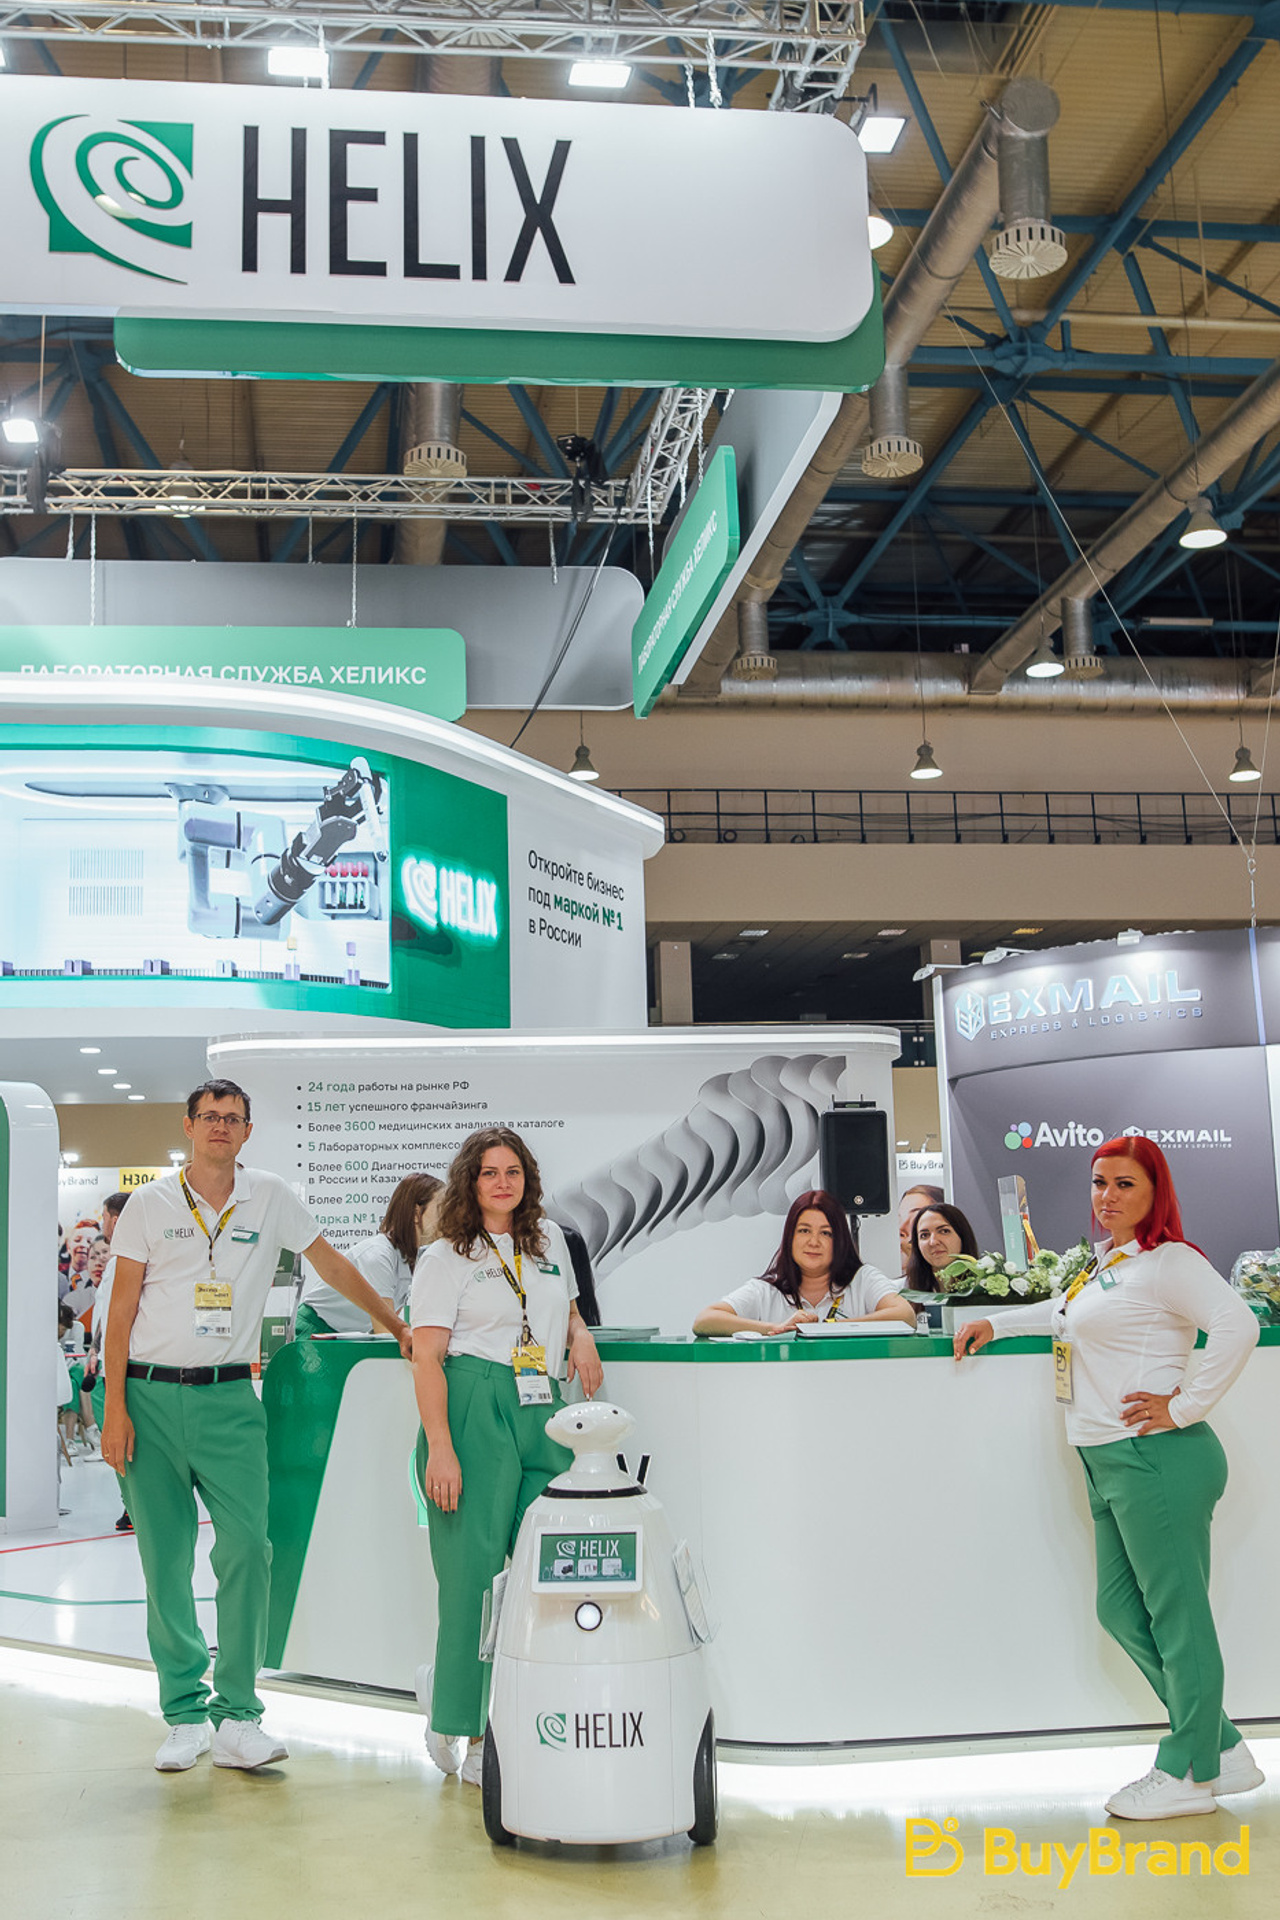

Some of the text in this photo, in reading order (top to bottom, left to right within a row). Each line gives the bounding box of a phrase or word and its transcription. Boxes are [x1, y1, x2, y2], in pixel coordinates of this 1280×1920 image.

[242, 125, 576, 285] HELIX
[220, 666, 324, 684] СЛУЖБА
[329, 666, 427, 685] ХЕЛИКС
[528, 849, 624, 901] Откройте бизнес
[439, 866, 498, 939] HELIX
[528, 886, 551, 911] под
[553, 894, 599, 925] маркой
[529, 918, 582, 948] в России
[987, 970, 1202, 1025] EXMAIL
[990, 1021, 1062, 1040] EXPRESS
[1089, 1007, 1203, 1027] LOGISTICS
[308, 1080, 470, 1093] 24 года работы на рынке РФ
[307, 1100, 488, 1114] 15 лет успешного франчайзинга
[308, 1122, 342, 1132] Более
[344, 1120, 376, 1131] 3600
[378, 1121, 452, 1132] медицинских
[517, 1119, 565, 1128] каталоге
[1034, 1121, 1104, 1148] Avito
[1145, 1129, 1232, 1143] EXMAIL
[308, 1140, 461, 1153] 5 Лабораторных комплексо
[308, 1160, 448, 1172] Более 600 Диагностичес
[910, 1160, 943, 1170] BuyBra
[308, 1174, 402, 1184] в России и Казах
[308, 1193, 390, 1206] Более 200 гор
[175, 1227, 194, 1239] HELIX
[320, 1228, 373, 1238] бедитель
[580, 1539, 619, 1558] HELIX
[575, 1711, 644, 1749] HELIX
